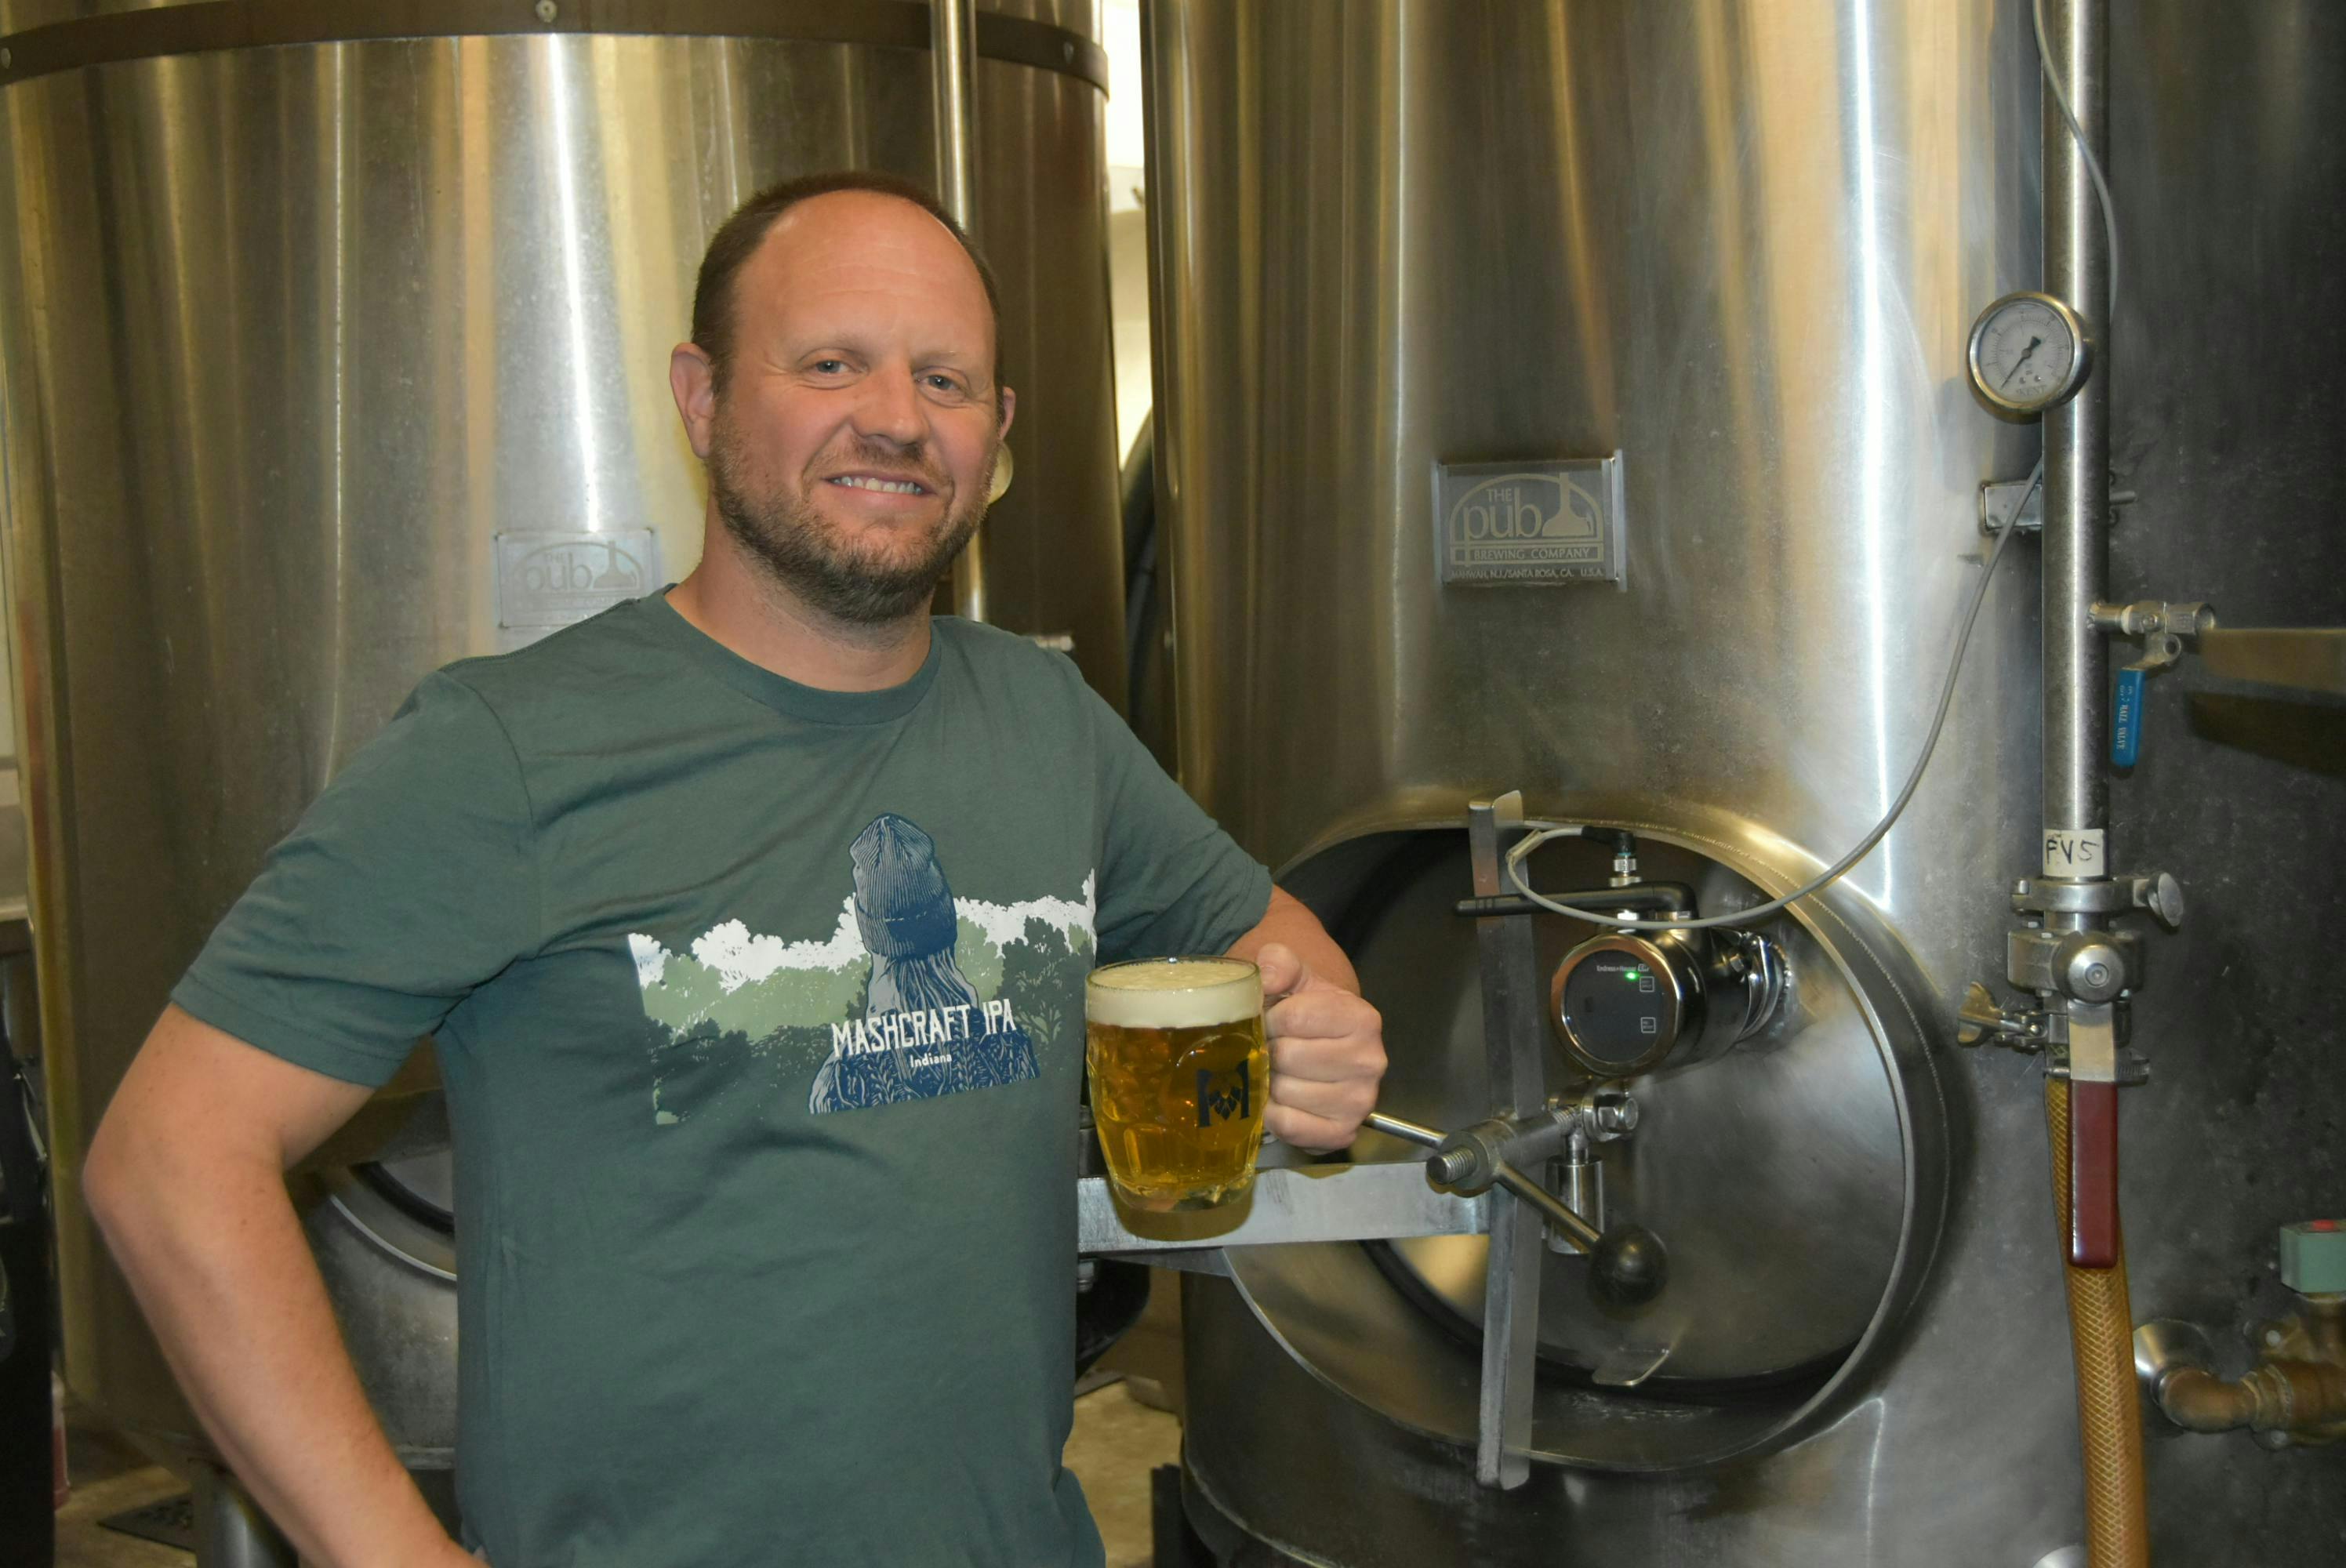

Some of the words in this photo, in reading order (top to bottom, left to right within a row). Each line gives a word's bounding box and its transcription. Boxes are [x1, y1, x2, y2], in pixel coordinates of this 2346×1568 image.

[1487, 488, 1512, 502] THE
[1464, 487, 1542, 567] pub
[1473, 549, 1524, 561] BREWING
[1531, 547, 1590, 559] COMPANY
[831, 1004, 971, 1058] MASHCRAFT
[982, 998, 1017, 1036] IPA
[910, 1052, 953, 1069] Indiana
